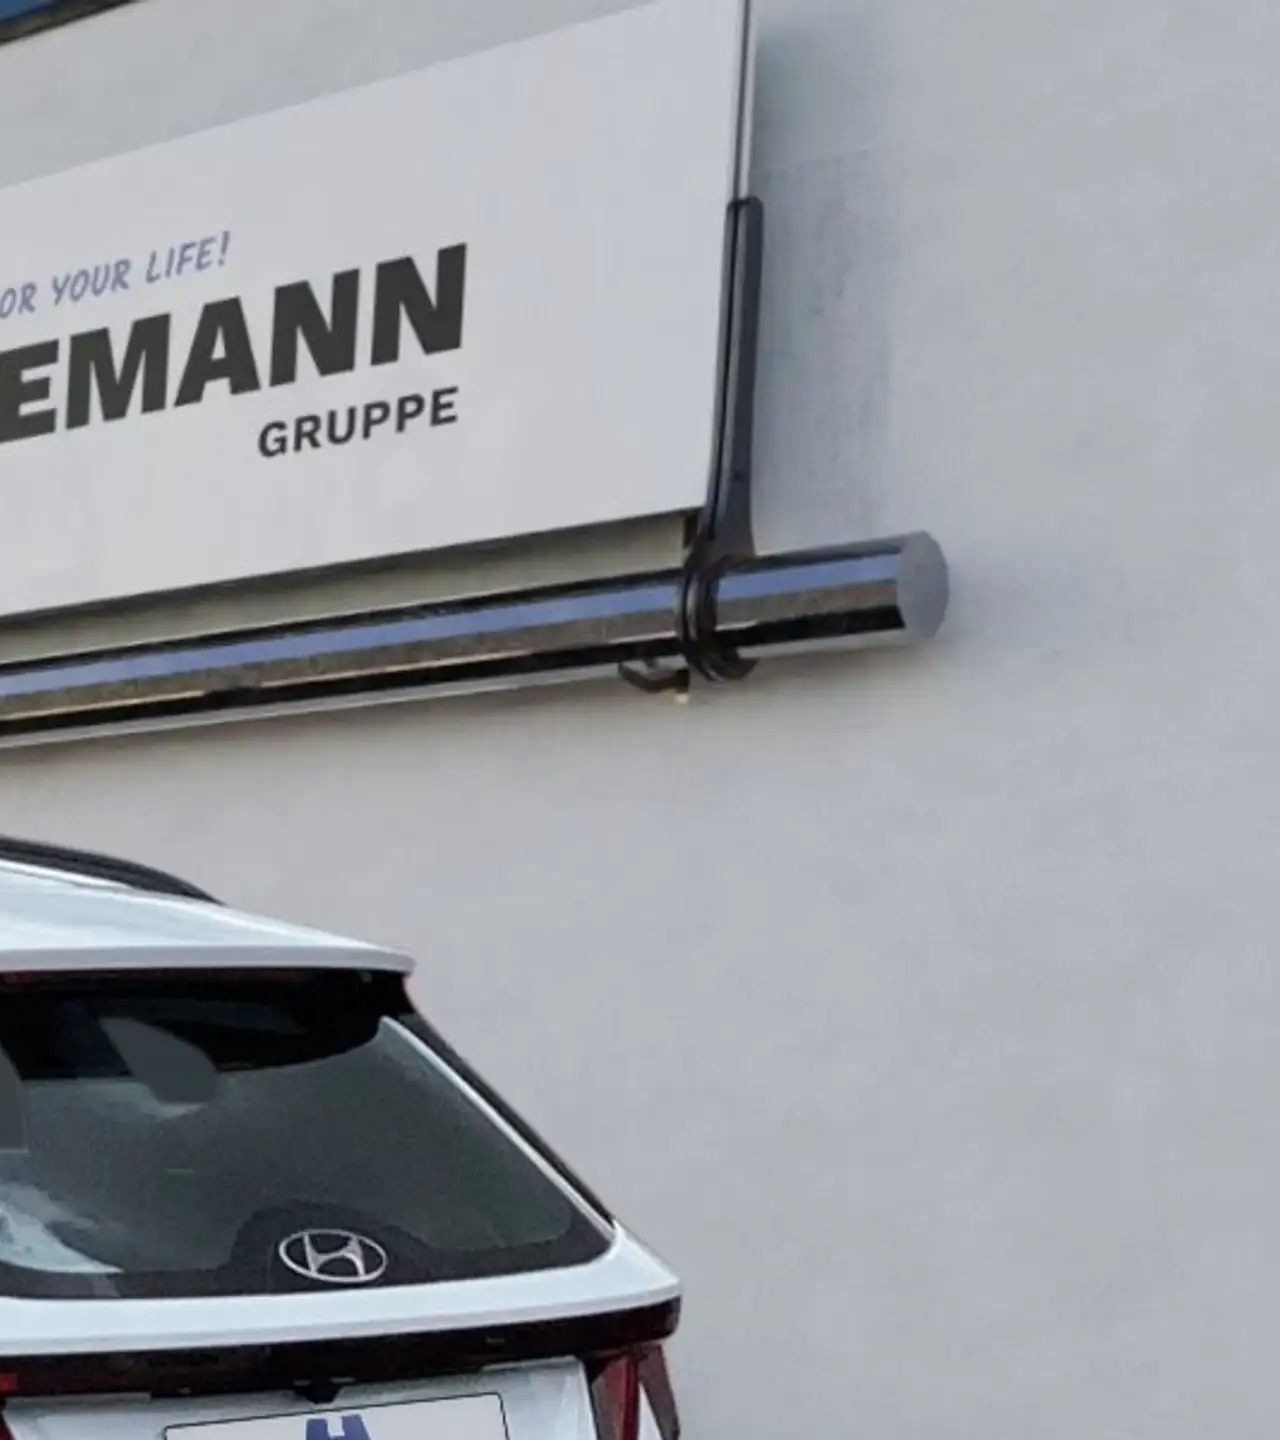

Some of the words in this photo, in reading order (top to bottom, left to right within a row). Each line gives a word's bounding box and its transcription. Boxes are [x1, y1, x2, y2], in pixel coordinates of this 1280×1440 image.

[51, 257, 132, 307] YOUR
[144, 230, 232, 285] LIFE!
[258, 387, 458, 458] GRUPPE
